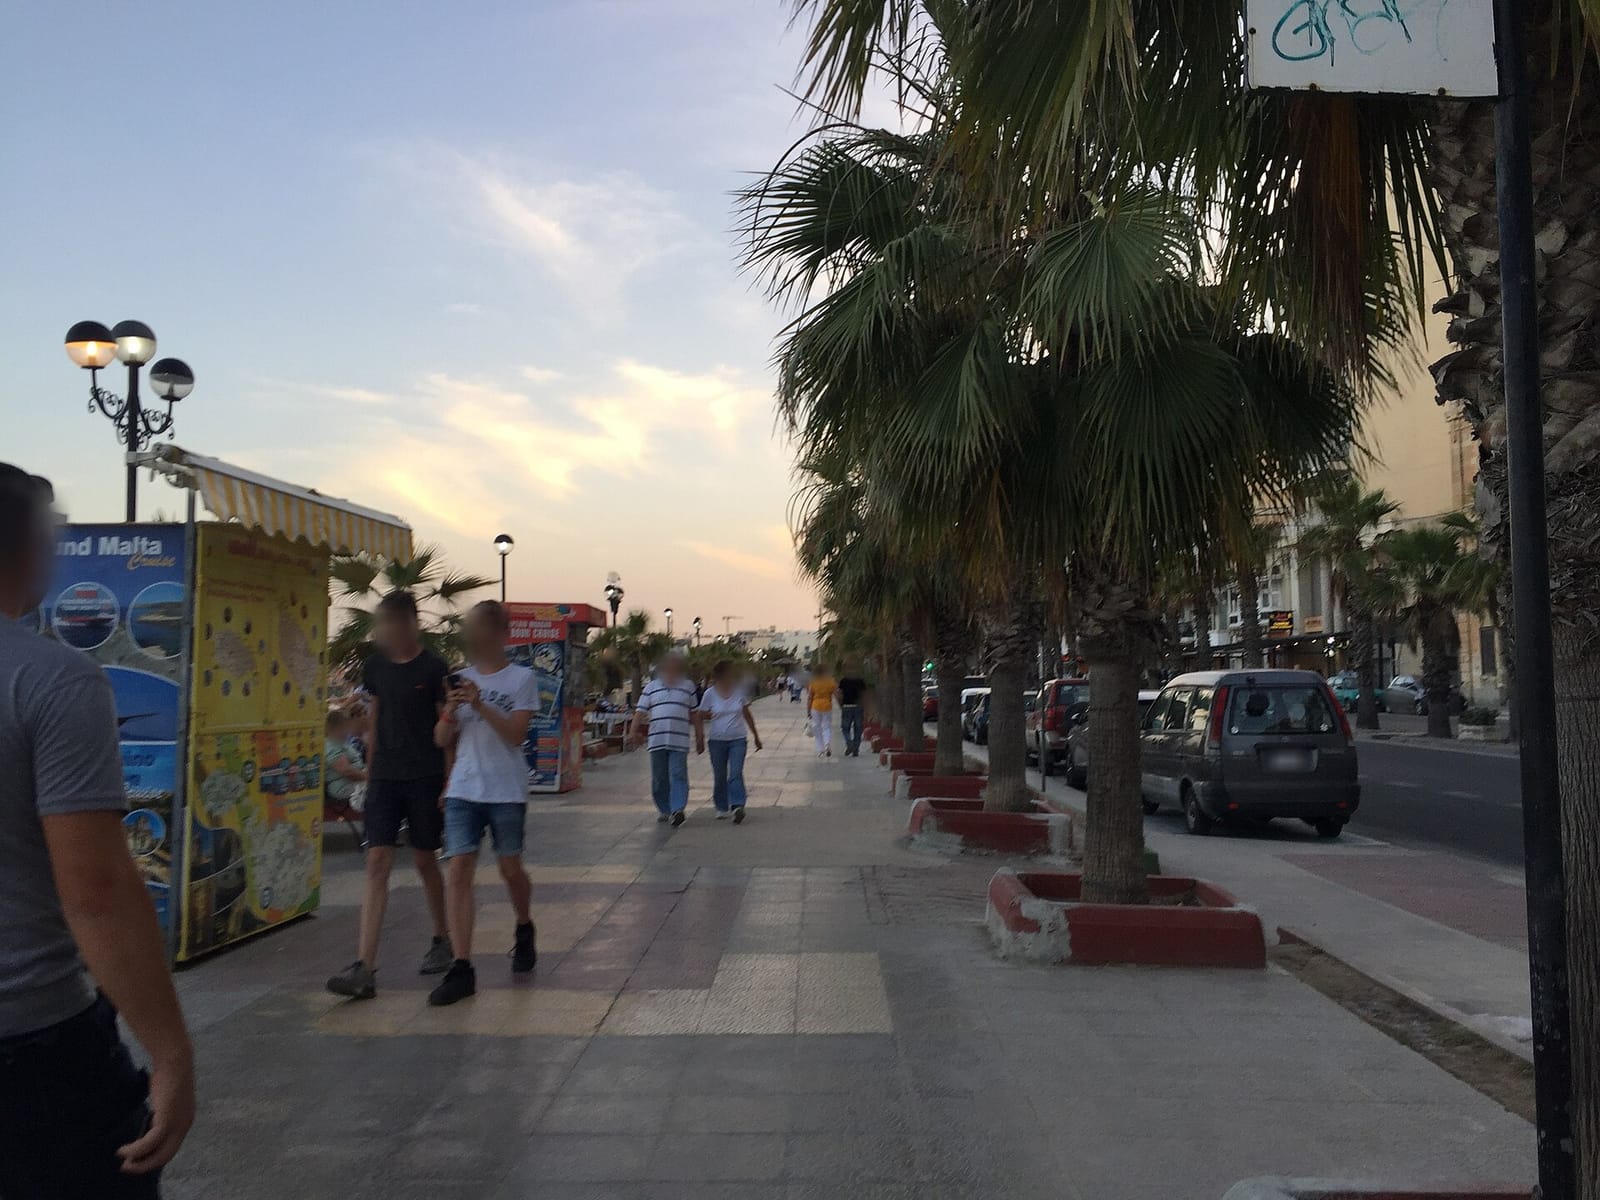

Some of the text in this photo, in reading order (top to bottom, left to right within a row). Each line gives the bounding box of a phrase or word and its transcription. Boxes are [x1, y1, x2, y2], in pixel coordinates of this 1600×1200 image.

[98, 536, 163, 556] Malta
[127, 553, 176, 570] Cruise
[533, 628, 561, 639] CRUISE
